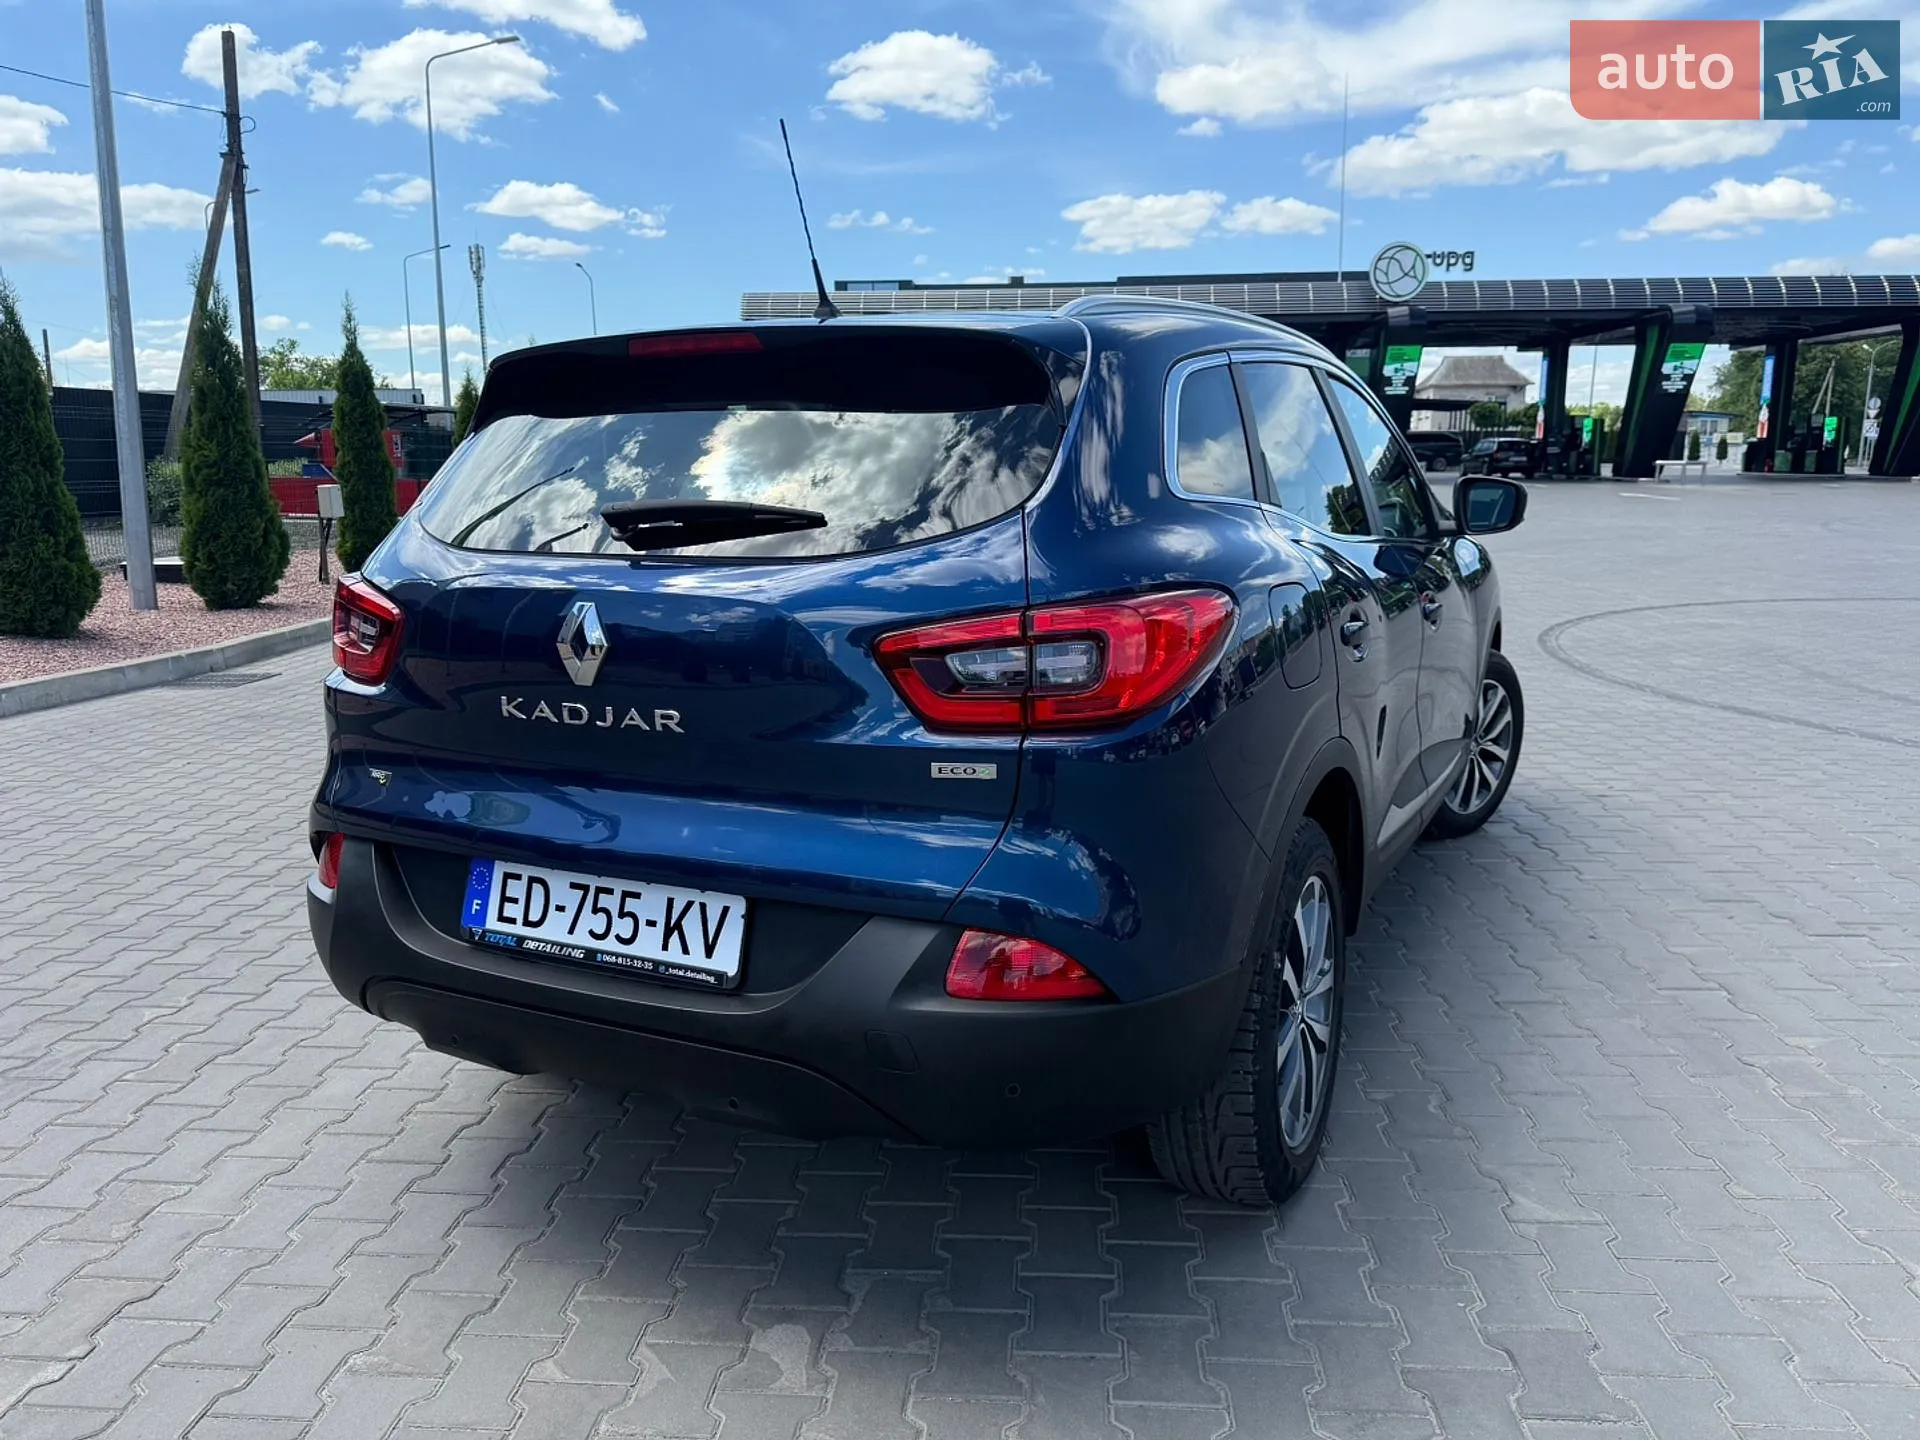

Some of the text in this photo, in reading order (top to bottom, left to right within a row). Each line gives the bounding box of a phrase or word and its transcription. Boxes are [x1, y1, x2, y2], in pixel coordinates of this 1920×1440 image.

[500, 695, 685, 733] KADJAR
[471, 900, 482, 915] F
[496, 870, 731, 960] ED-755-KV
[484, 932, 518, 948] TOTAL
